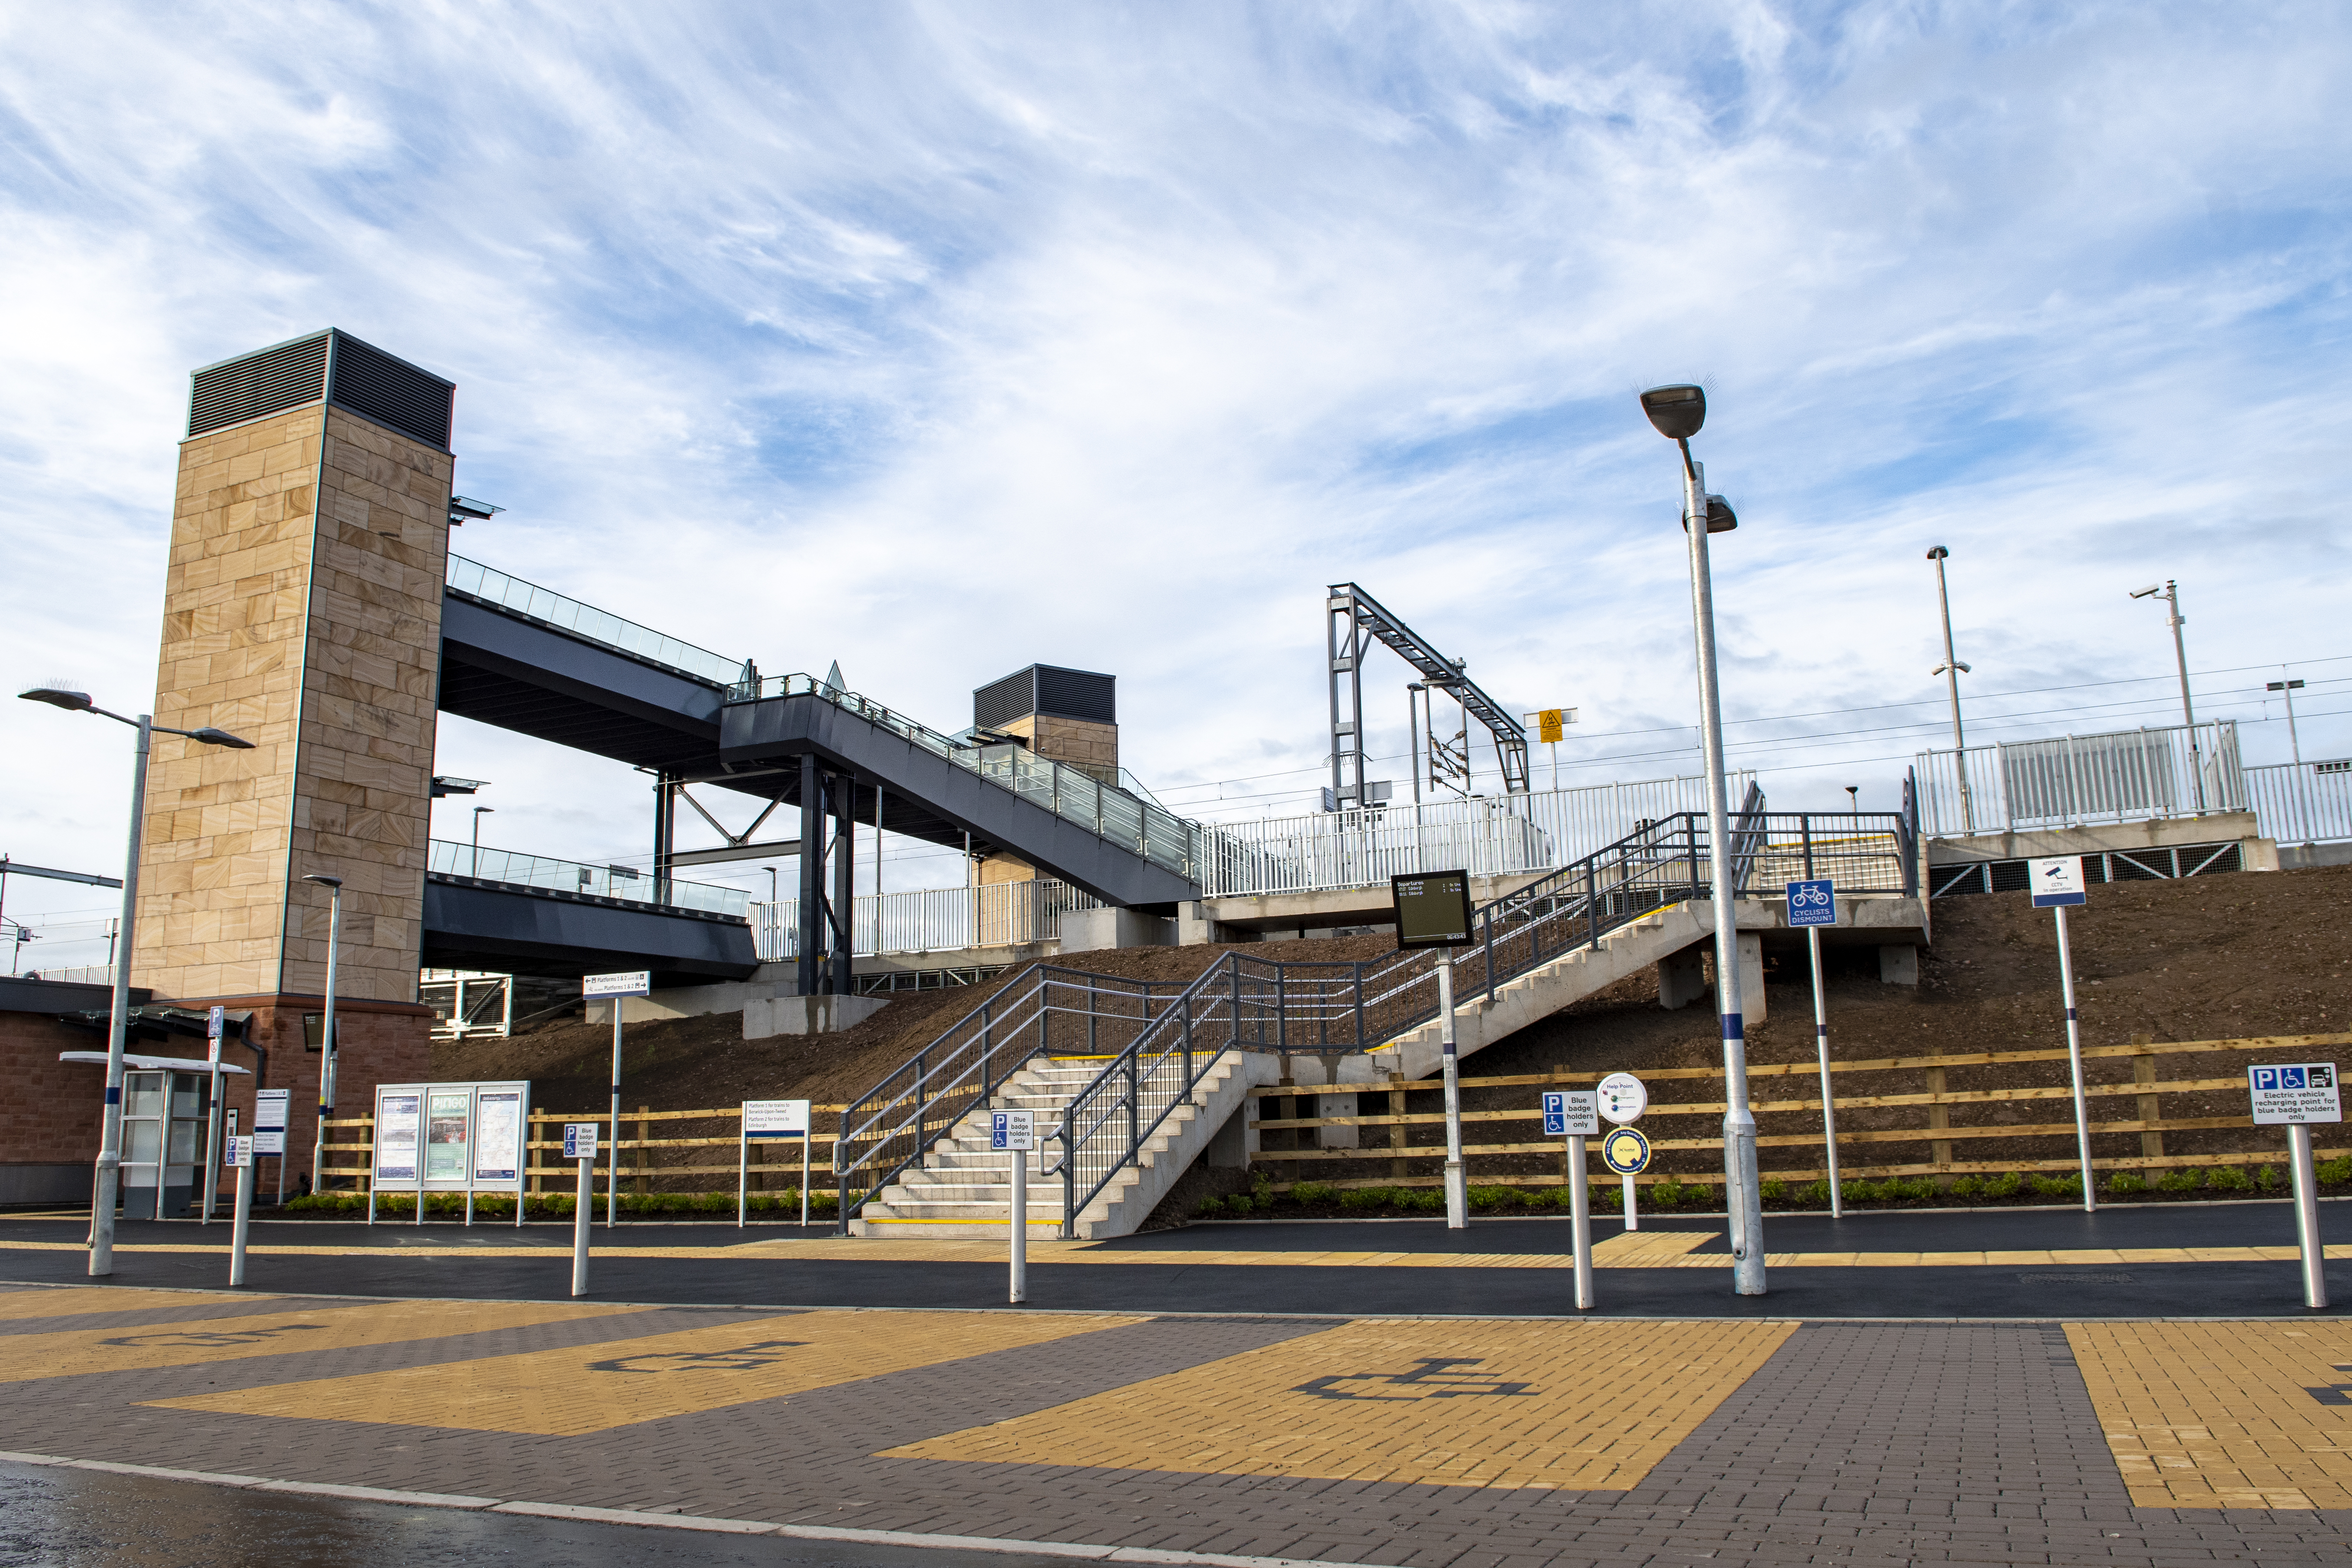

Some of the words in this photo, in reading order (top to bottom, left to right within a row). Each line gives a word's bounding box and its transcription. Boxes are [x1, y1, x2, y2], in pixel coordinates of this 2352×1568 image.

[584, 871, 588, 880] 1
[1792, 915, 1832, 923] DISMOUNT
[213, 1008, 220, 1023] P
[2257, 1070, 2273, 1088] P
[1548, 1096, 1559, 1112] P
[996, 1116, 1005, 1129] P
[568, 1127, 575, 1139] P
[1607, 1132, 1619, 1147] Questions?
[230, 1139, 235, 1150] P
